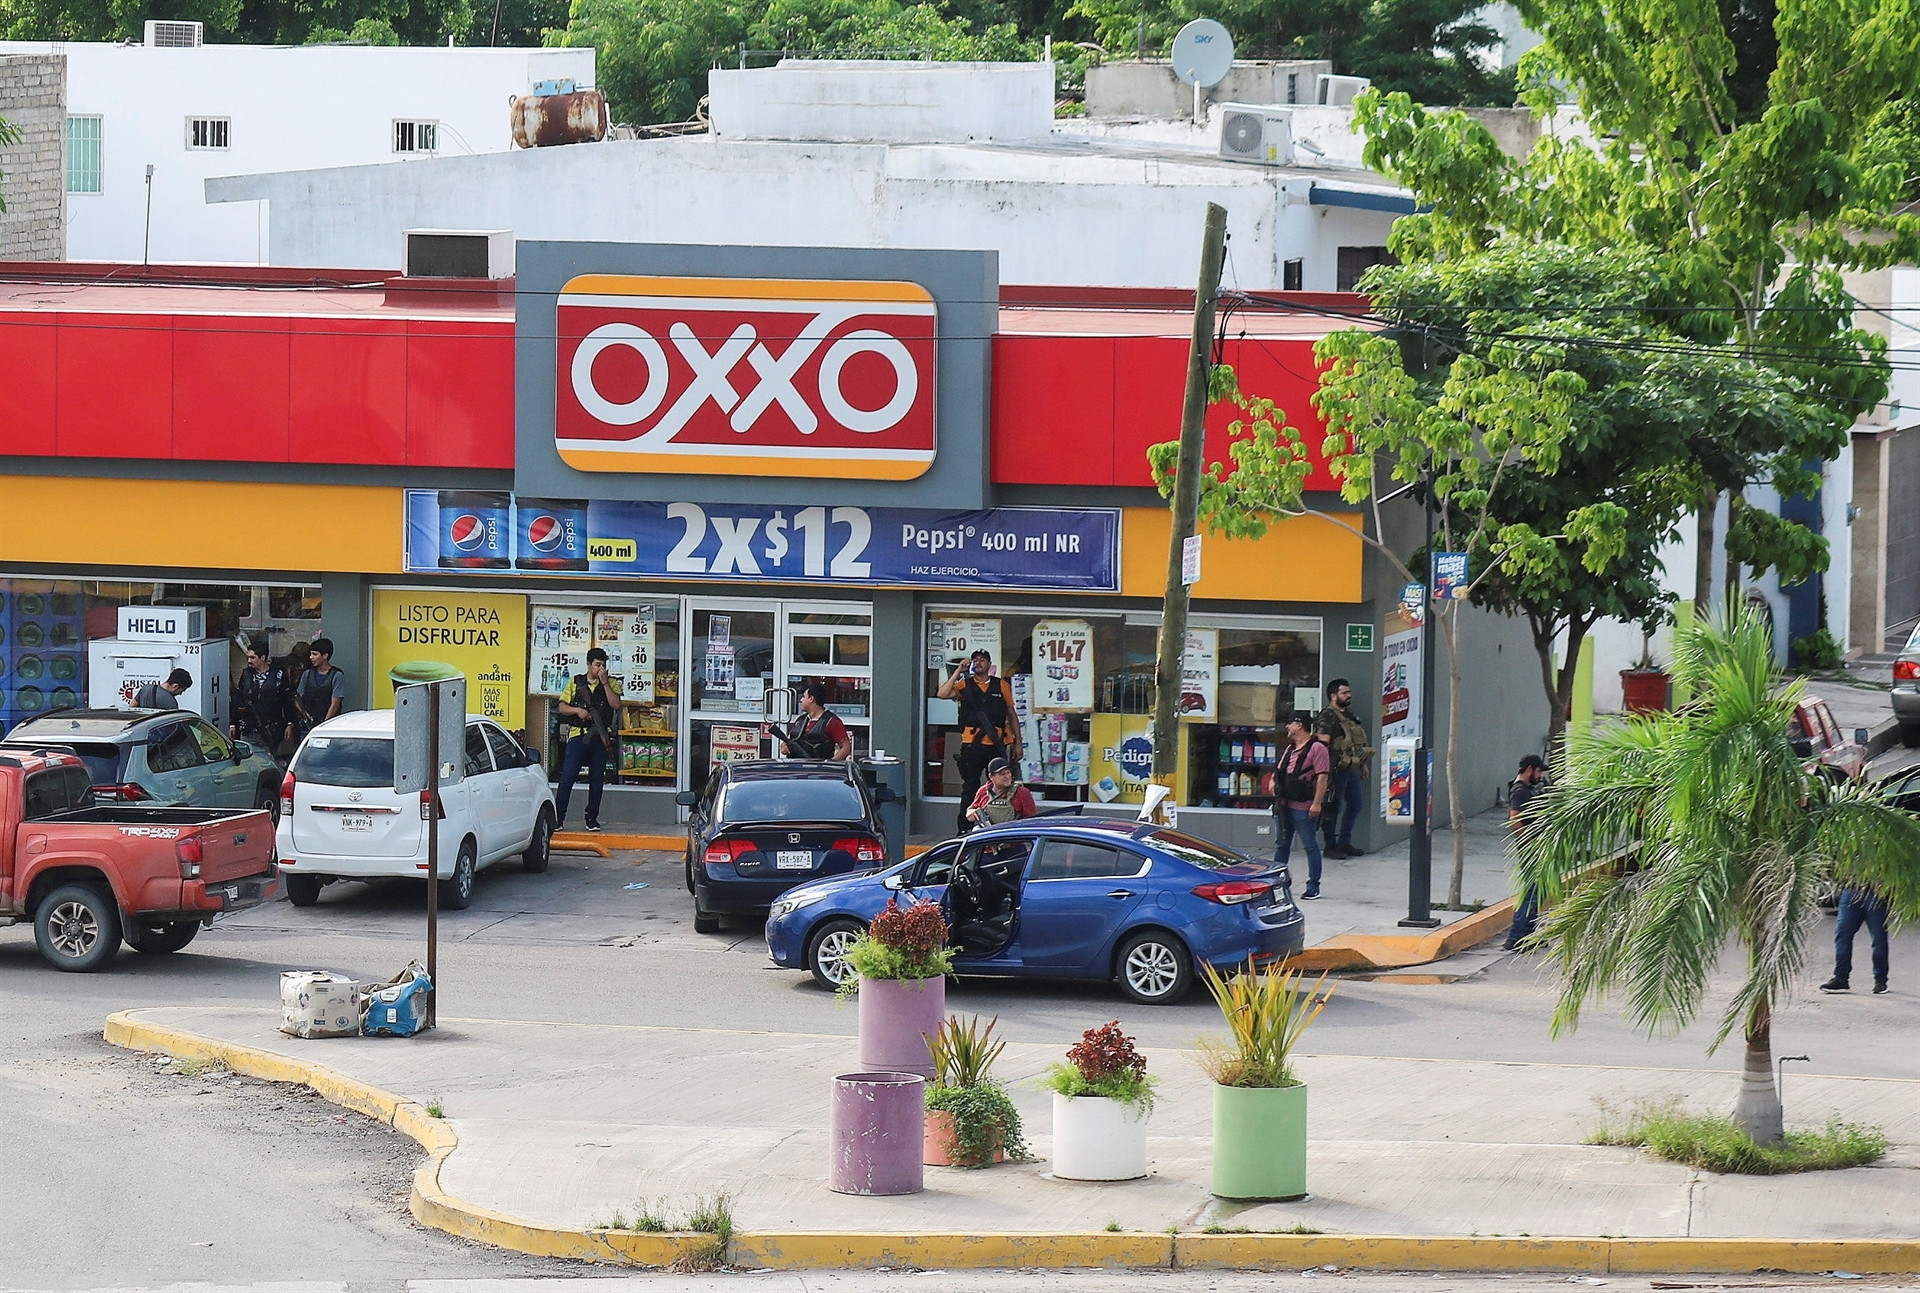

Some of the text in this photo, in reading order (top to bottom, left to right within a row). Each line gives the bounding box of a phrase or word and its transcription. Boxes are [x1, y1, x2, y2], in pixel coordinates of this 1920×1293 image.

[1195, 35, 1214, 44] SKY
[570, 320, 919, 436] OXXO
[486, 516, 498, 551] pepsi
[564, 517, 575, 552] pepsi
[981, 532, 1017, 551] 400
[1024, 533, 1048, 552] ml
[1055, 534, 1081, 553] NR
[590, 545, 632, 558] 400 ml
[911, 566, 930, 575] HAZ
[931, 566, 981, 577] EJERCICIO.
[399, 605, 501, 624] LISTO PARA
[128, 618, 176, 634] HIELO
[631, 624, 648, 635] $36
[399, 627, 500, 647] DISFRUTAR
[184, 645, 200, 654] 723
[946, 637, 967, 651] $10
[1039, 639, 1086, 663] $147
[551, 653, 568, 666] $15
[631, 653, 647, 664] $10
[477, 671, 511, 682] andatti
[484, 702, 496, 710] UN
[484, 708, 505, 717] CAFÉ
